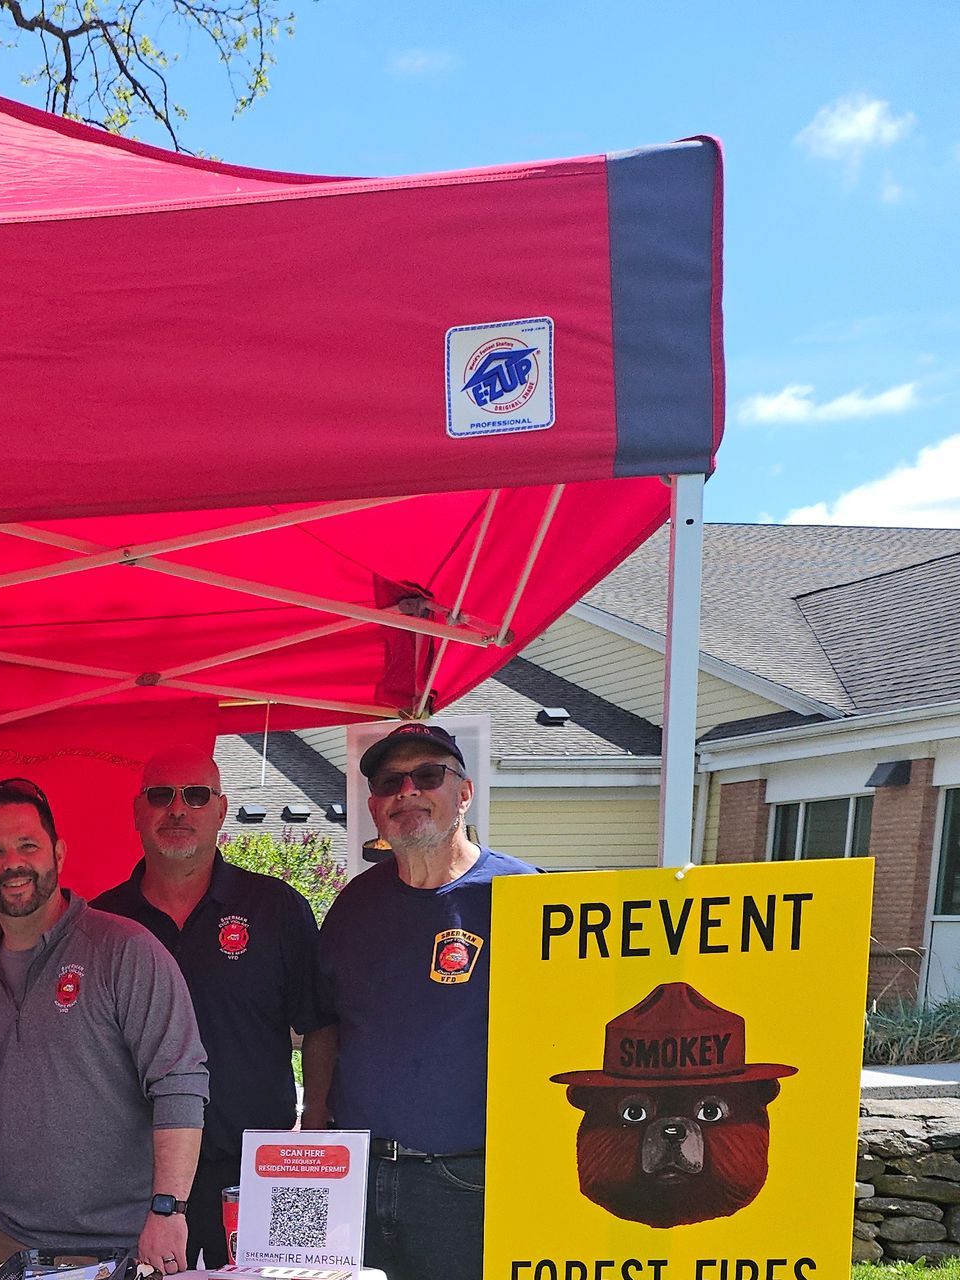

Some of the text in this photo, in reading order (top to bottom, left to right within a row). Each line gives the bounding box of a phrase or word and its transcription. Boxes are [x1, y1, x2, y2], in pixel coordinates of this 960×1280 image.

[494, 381, 535, 412] ORIGINAL SHADE
[470, 418, 532, 430] PROFESSIONAL
[540, 892, 814, 961] PREVENT
[440, 930, 478, 944] SHERMAN
[619, 1033, 732, 1069] SMOKEY
[280, 1149, 326, 1157] SCAN HERE
[258, 1165, 300, 1173] RESIDENTIAL
[300, 1165, 320, 1173] BURN
[279, 1253, 302, 1264] FIRE
[305, 1254, 358, 1266] MARSHAL
